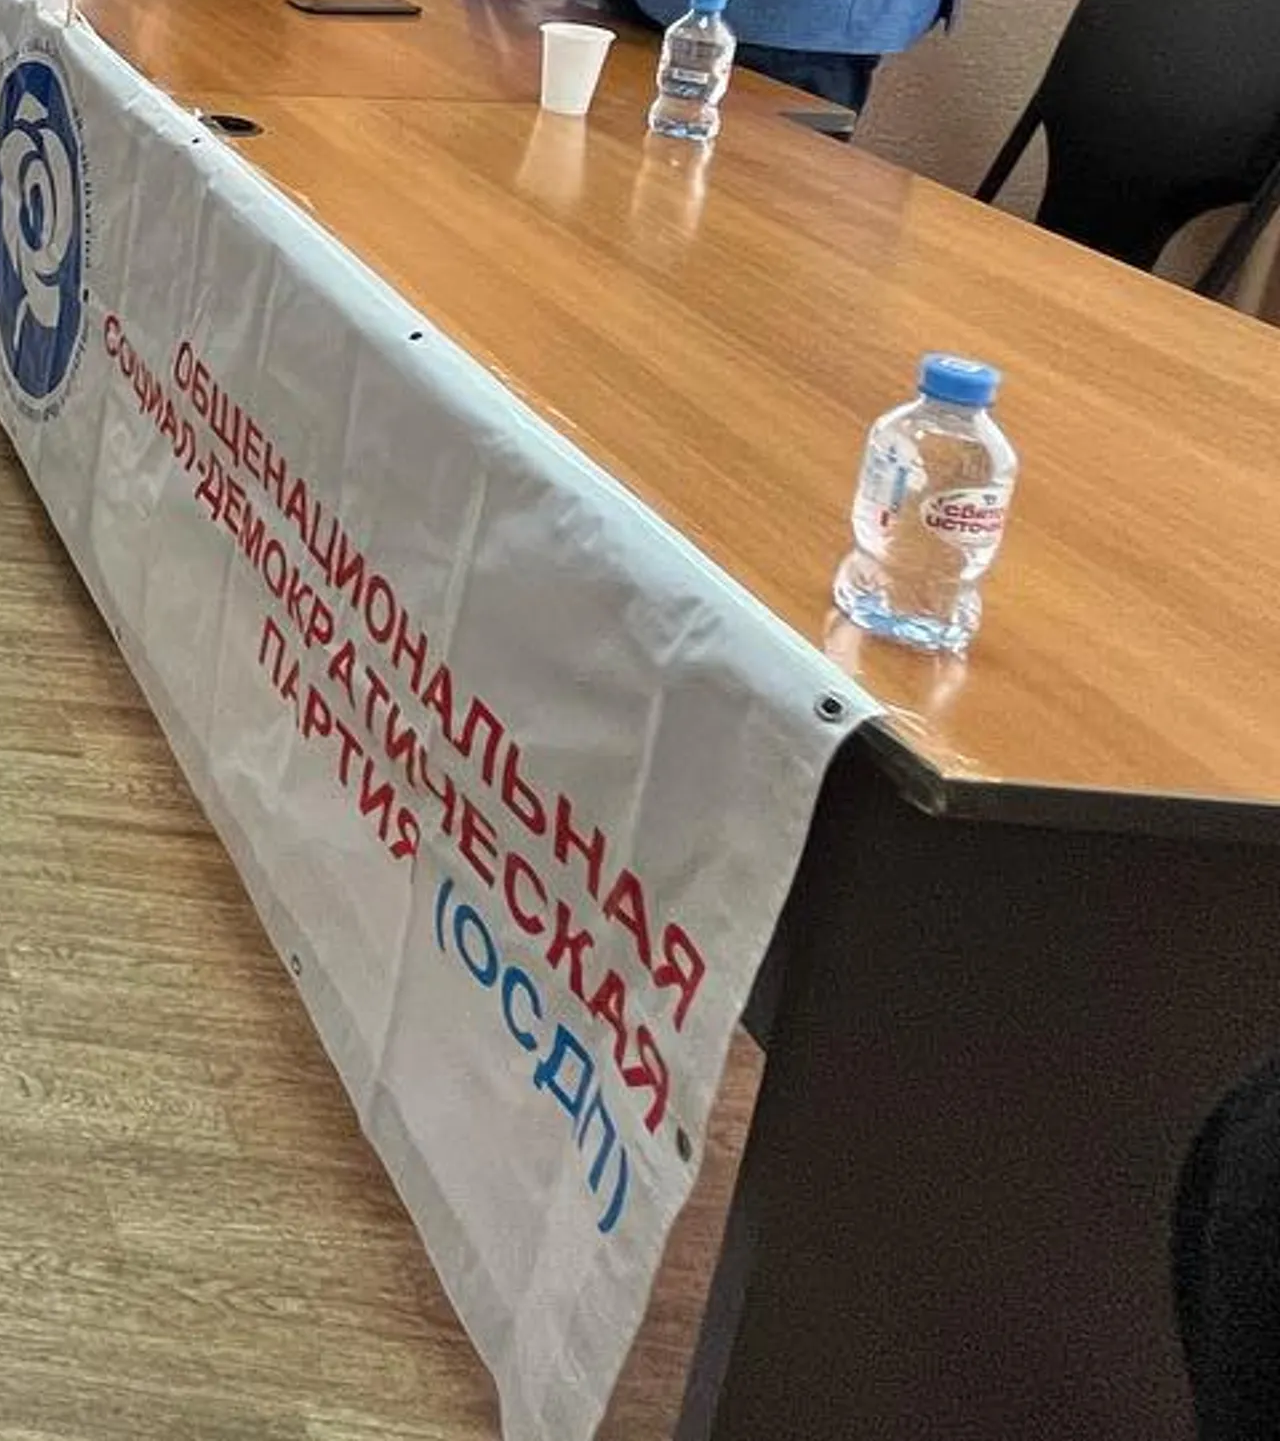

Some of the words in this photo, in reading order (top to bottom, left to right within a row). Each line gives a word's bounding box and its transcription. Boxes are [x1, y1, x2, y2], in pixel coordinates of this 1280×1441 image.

[103, 314, 671, 1136] СОЦИАЛ-ДЕМОКРАТИЧЕСКАЯ
[172, 340, 706, 1031] ОБЩЕНАЦИОНАЛЬНАЯ
[257, 616, 421, 861] ПАРТИЯ
[434, 878, 630, 1234] (ОСДП)
